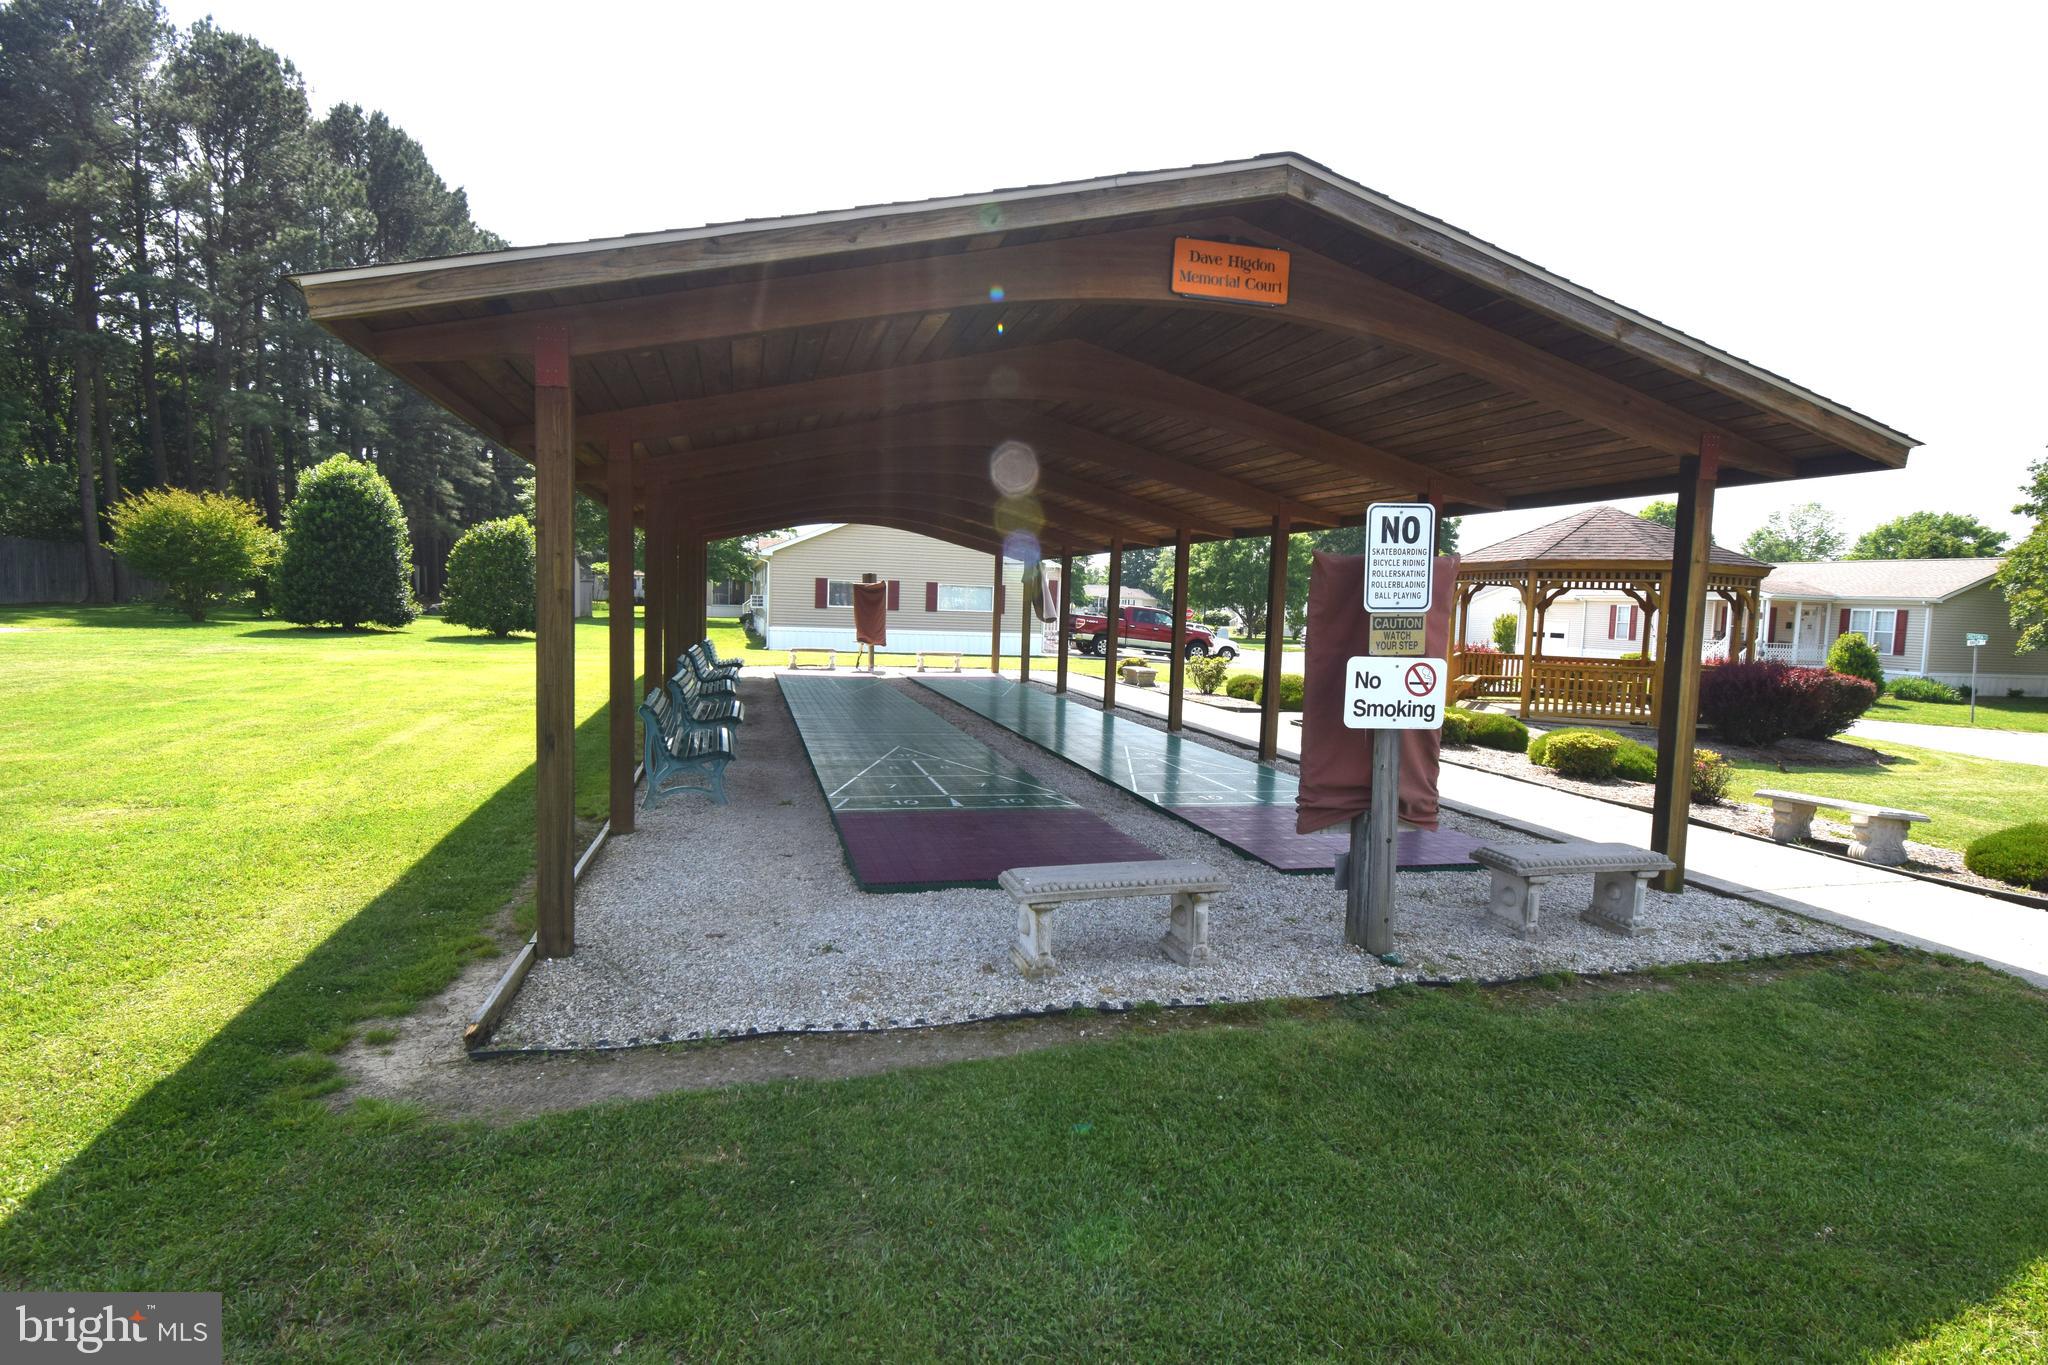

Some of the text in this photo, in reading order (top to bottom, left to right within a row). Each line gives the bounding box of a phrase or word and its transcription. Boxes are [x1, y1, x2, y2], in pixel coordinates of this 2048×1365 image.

[1189, 249, 1276, 274] Dave Higdon
[1179, 269, 1282, 293] Memorial Court
[1381, 515, 1421, 544] NO
[1371, 547, 1428, 556] SKATEBOARDING
[1372, 559, 1426, 567] BICYCLE RIDING
[1371, 570, 1426, 578] ROLLERSKATING
[1371, 581, 1426, 589] ROLLERBLADING
[1374, 592, 1422, 600] BALL PLAYING
[1373, 617, 1423, 629] CAUTION
[1383, 631, 1411, 640] WATCH
[1375, 641, 1419, 650] YOUR STEP
[1354, 671, 1382, 689] No
[1353, 698, 1436, 723] Smoking
